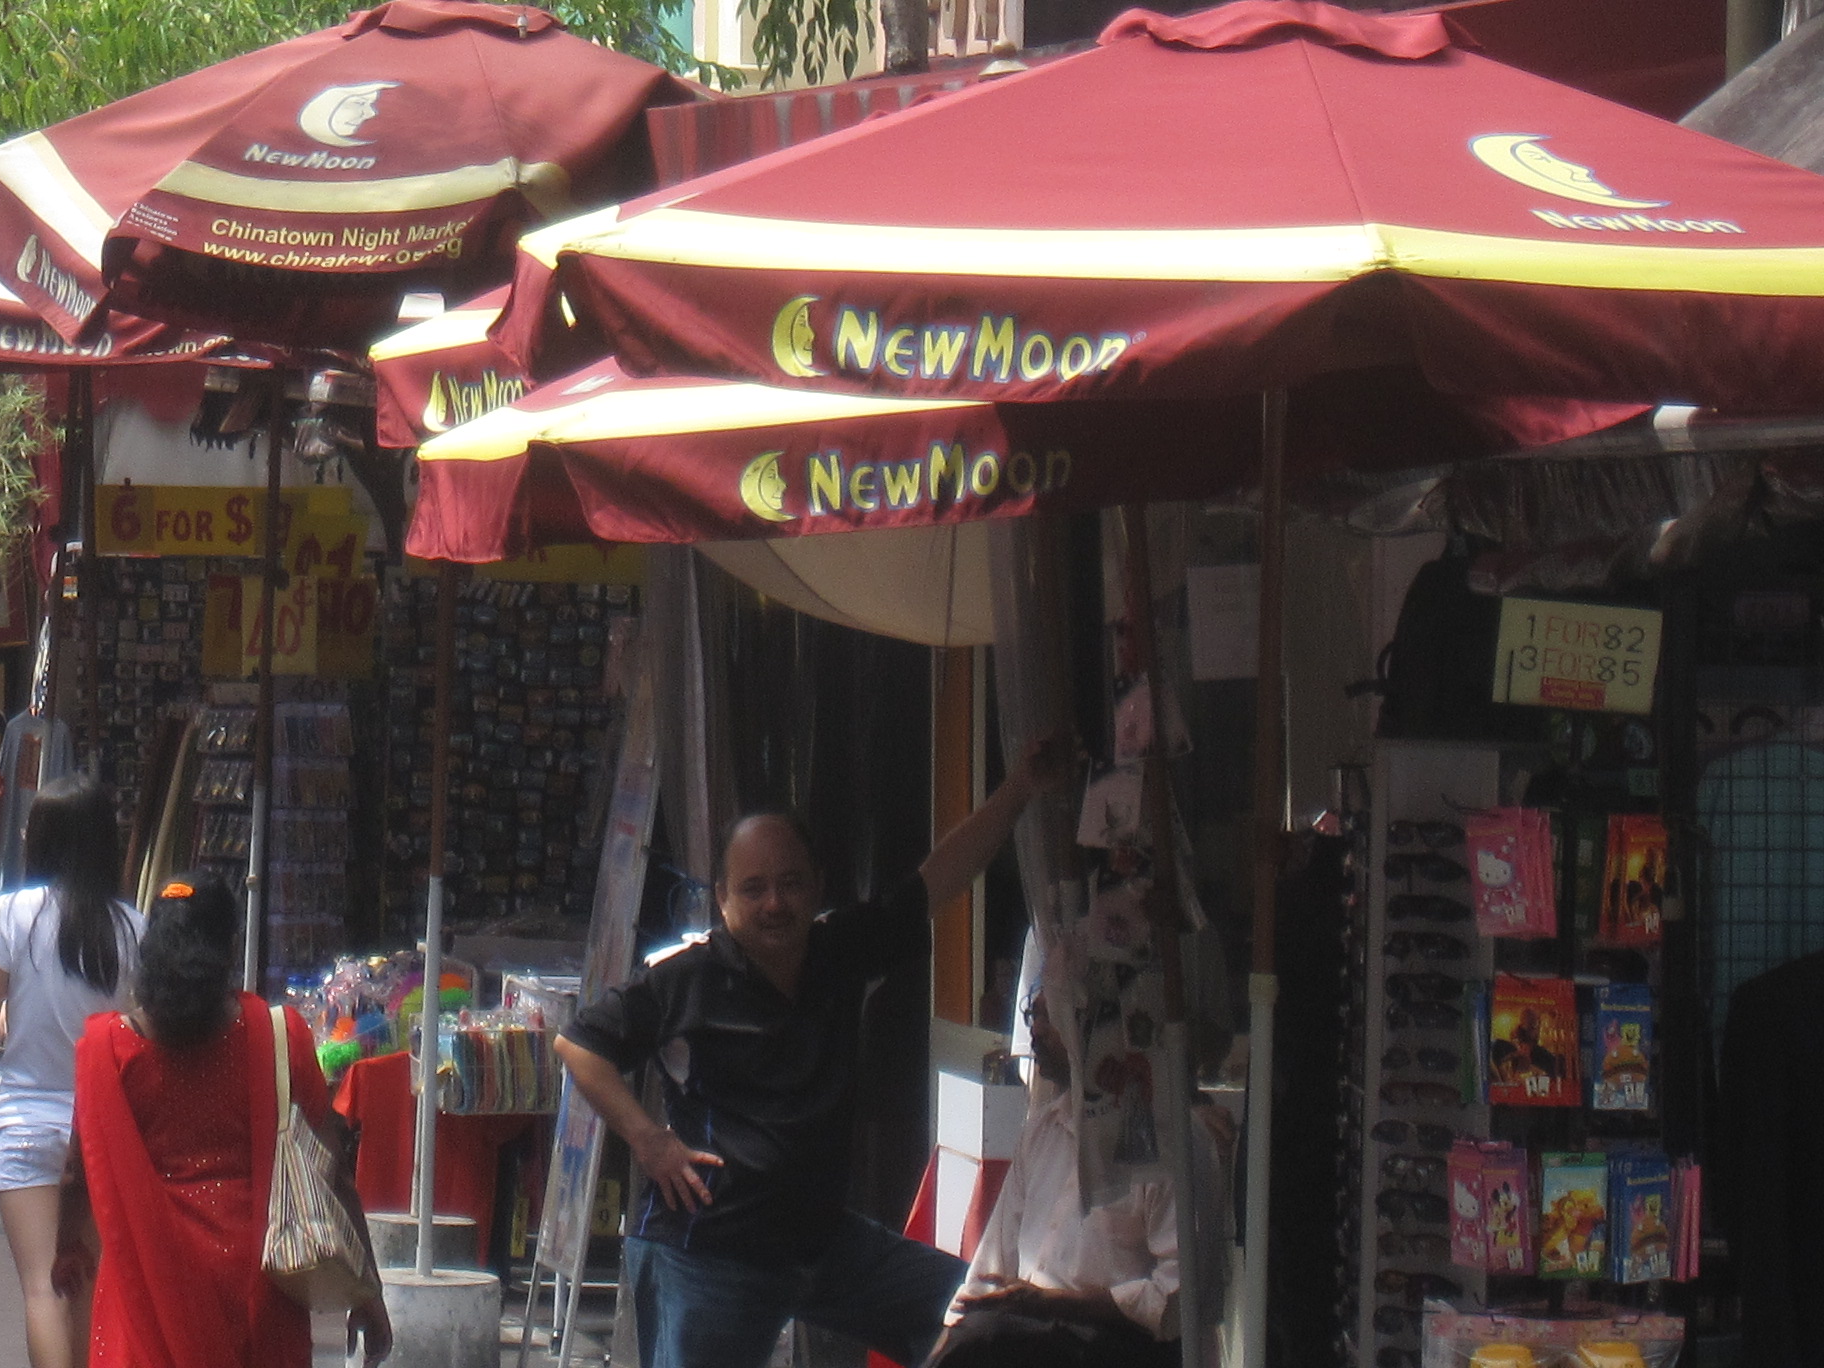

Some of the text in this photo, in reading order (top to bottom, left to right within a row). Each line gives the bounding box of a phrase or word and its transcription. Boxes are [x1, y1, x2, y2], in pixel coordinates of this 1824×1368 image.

[210, 218, 335, 248] Chinatown
[340, 227, 402, 252] Night
[156, 510, 215, 543] FOR
[1526, 613, 1537, 640] 1
[1544, 615, 1601, 649] FOR
[1541, 647, 1597, 681] FOR
